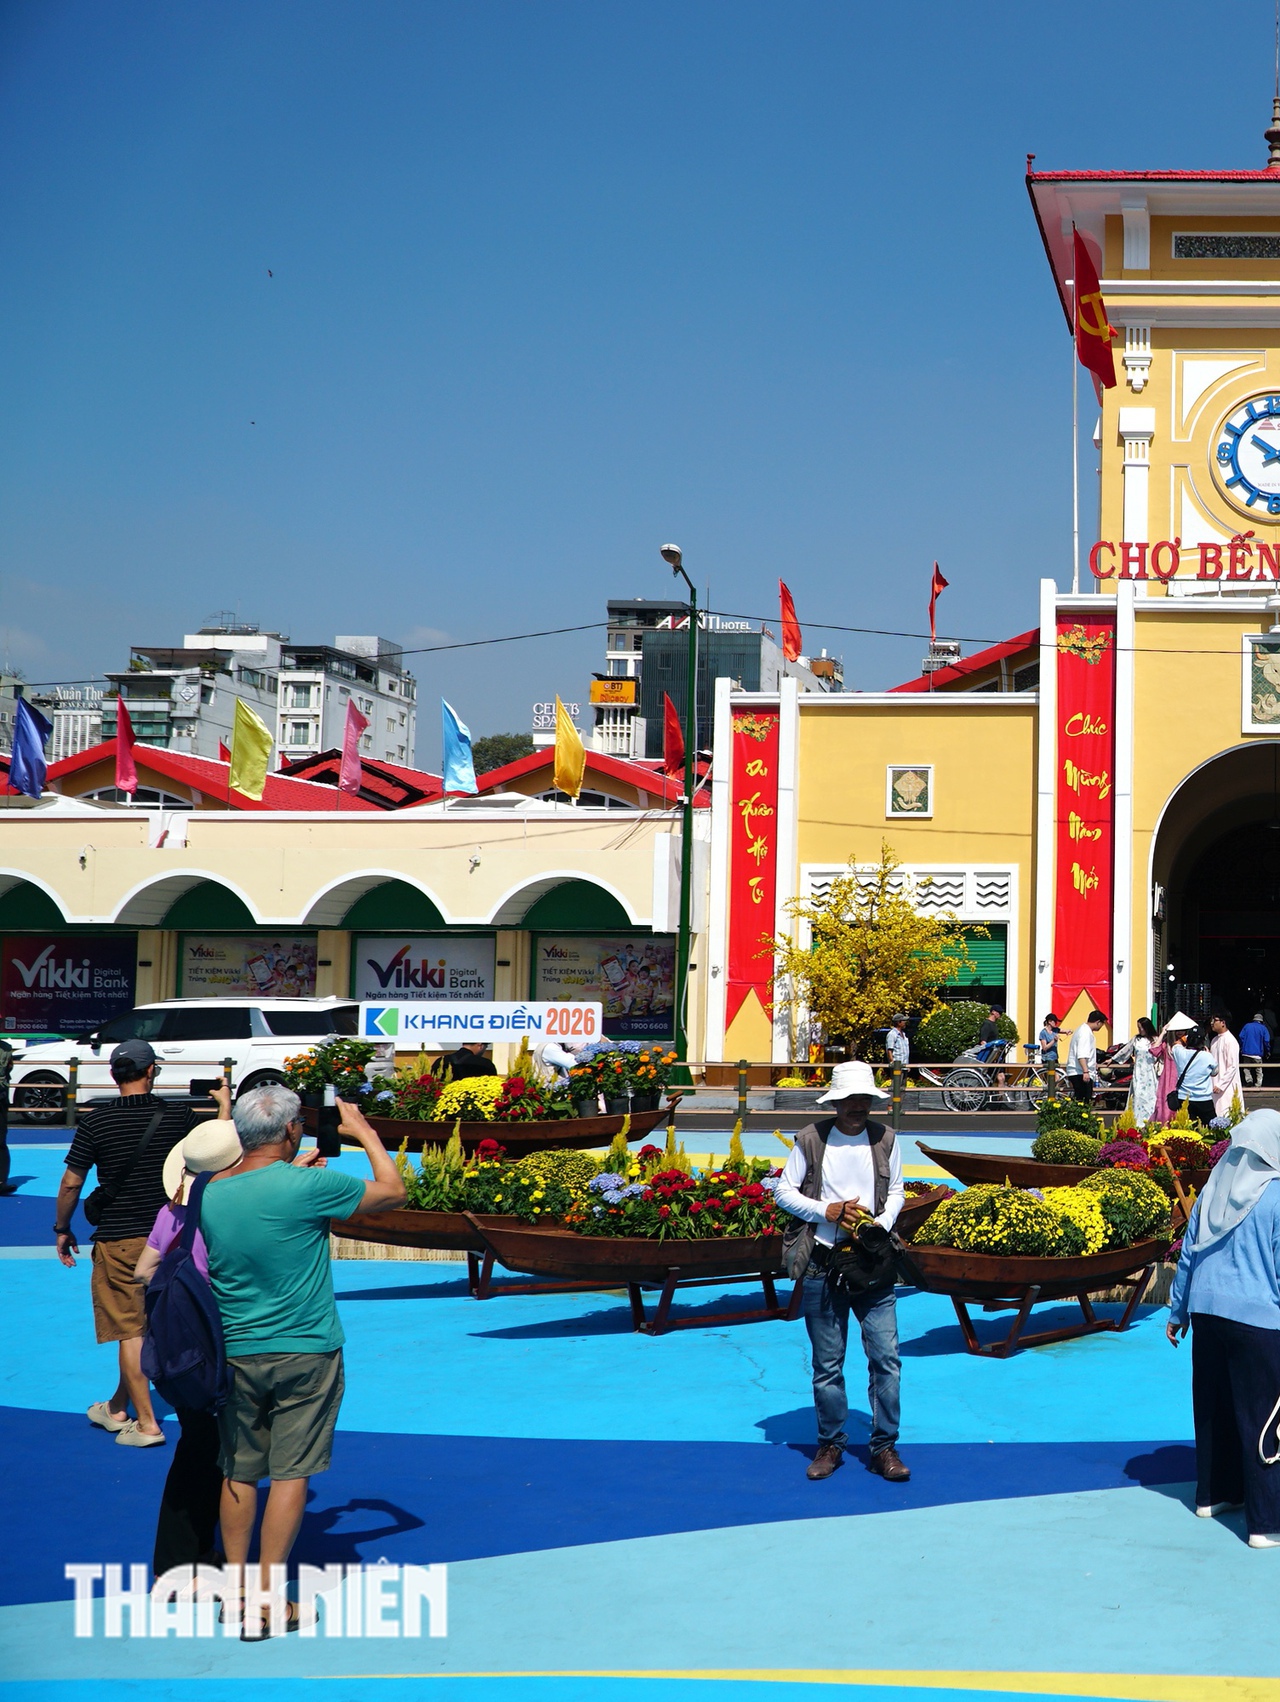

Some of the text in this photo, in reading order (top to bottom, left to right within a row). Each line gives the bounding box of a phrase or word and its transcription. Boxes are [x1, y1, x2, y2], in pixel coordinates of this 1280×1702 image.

[1088, 536, 1182, 584] CHỢ
[1198, 530, 1280, 580] BẾN
[722, 621, 752, 630] HOTEL
[56, 686, 82, 700] Xuân
[533, 716, 556, 727] SPA
[1064, 712, 1108, 736] Chúc
[1064, 758, 1113, 800] Mừng
[738, 792, 774, 839] Xuân
[1068, 811, 1102, 846] Năm
[746, 835, 768, 866] Hội
[1070, 862, 1099, 900] Mới
[189, 944, 214, 957] Vikki
[543, 944, 568, 958] Vikki
[12, 944, 90, 988] Vikki
[94, 968, 121, 977] Digital
[367, 944, 446, 988] Vikki
[450, 968, 477, 977] Digital
[94, 977, 128, 988] Bank
[450, 977, 485, 988] Bank
[10, 990, 128, 999] Ngân hàng Tiết kiệm Tốt nhất!
[366, 990, 485, 1000] Ngân hàng Tiết kiệm Tốt nhất!
[404, 1006, 596, 1036] KHANG ĐIỀN 2026
